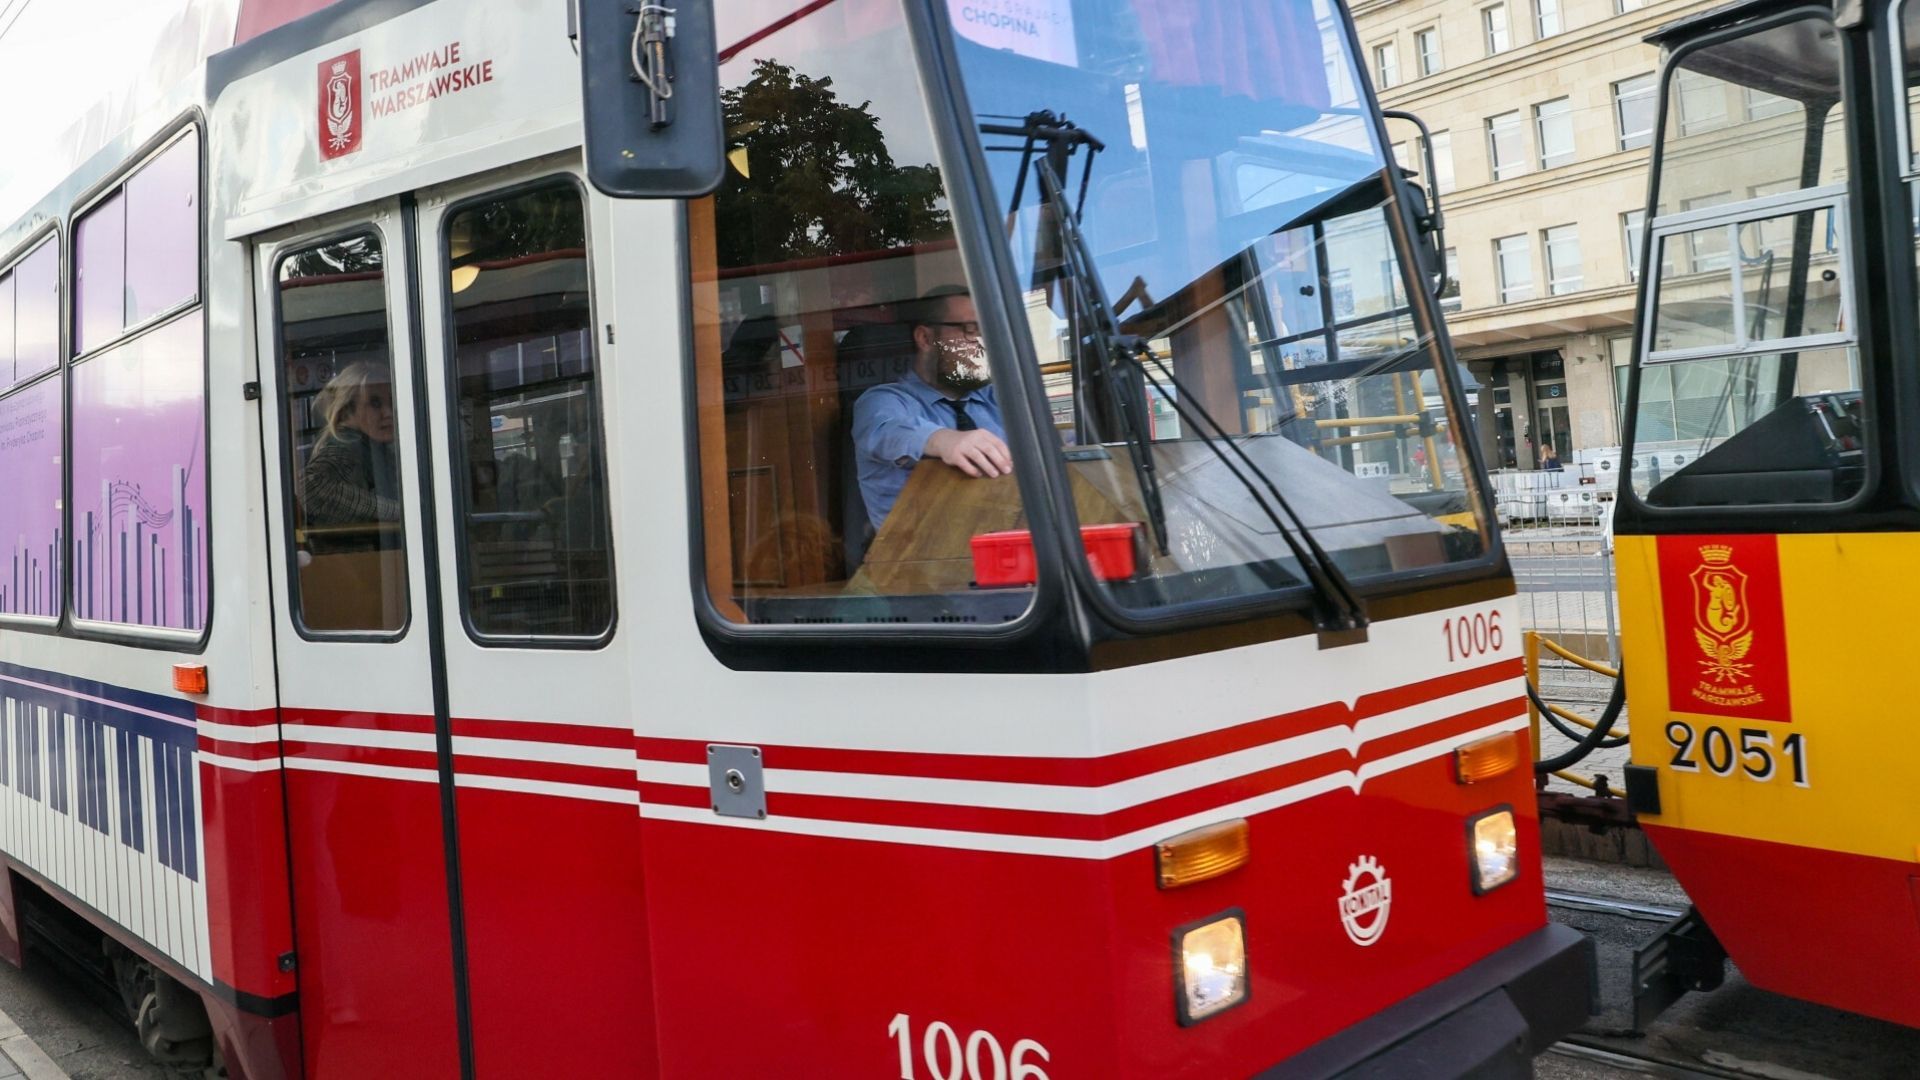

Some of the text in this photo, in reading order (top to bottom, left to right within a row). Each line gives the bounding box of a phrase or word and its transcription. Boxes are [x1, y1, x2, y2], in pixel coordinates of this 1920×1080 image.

[962, 7, 1040, 37] CHOPINA
[370, 41, 460, 93] TRAMWAJE
[371, 60, 493, 119] WARSZAWSKIE
[1443, 610, 1502, 662] 1006
[1692, 688, 1764, 706] WARSZAWSKIE
[1699, 681, 1755, 695] TRAMWAJE
[1665, 721, 1810, 788] 2051
[888, 1013, 1050, 1080] 1006
